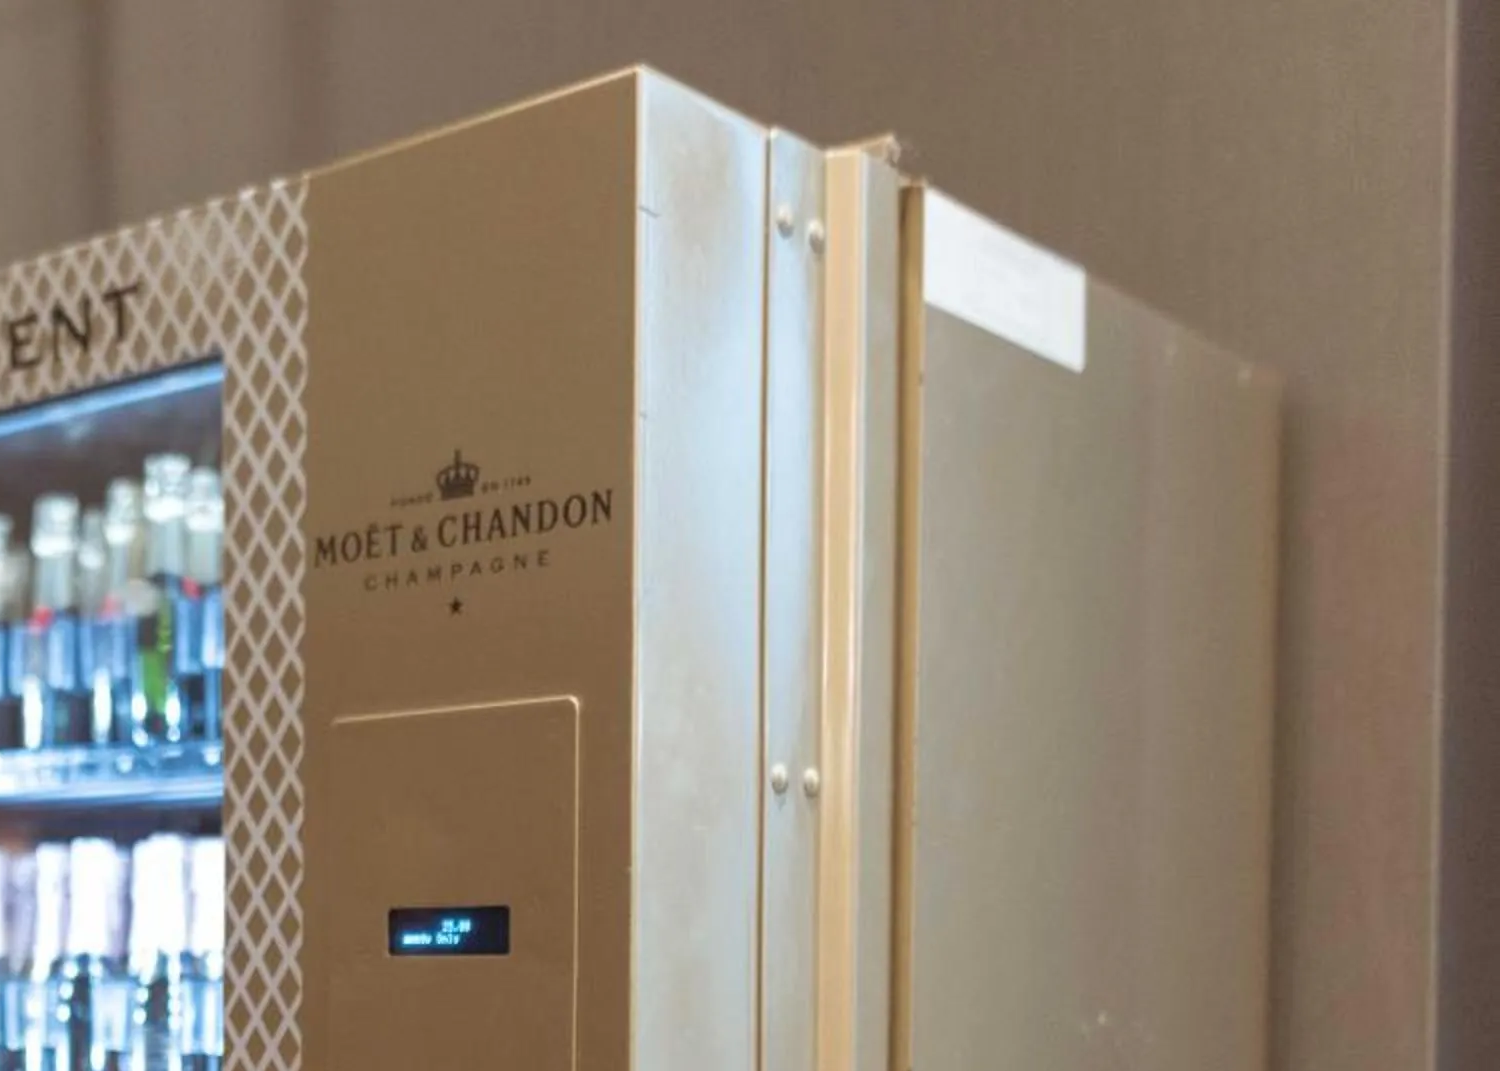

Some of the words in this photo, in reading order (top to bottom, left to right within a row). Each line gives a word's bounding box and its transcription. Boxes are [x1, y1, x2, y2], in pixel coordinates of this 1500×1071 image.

[313, 522, 404, 568] MOËT
[410, 524, 428, 553] &
[436, 488, 614, 549] CHANDON
[363, 549, 551, 592] CHAMPAGNE
